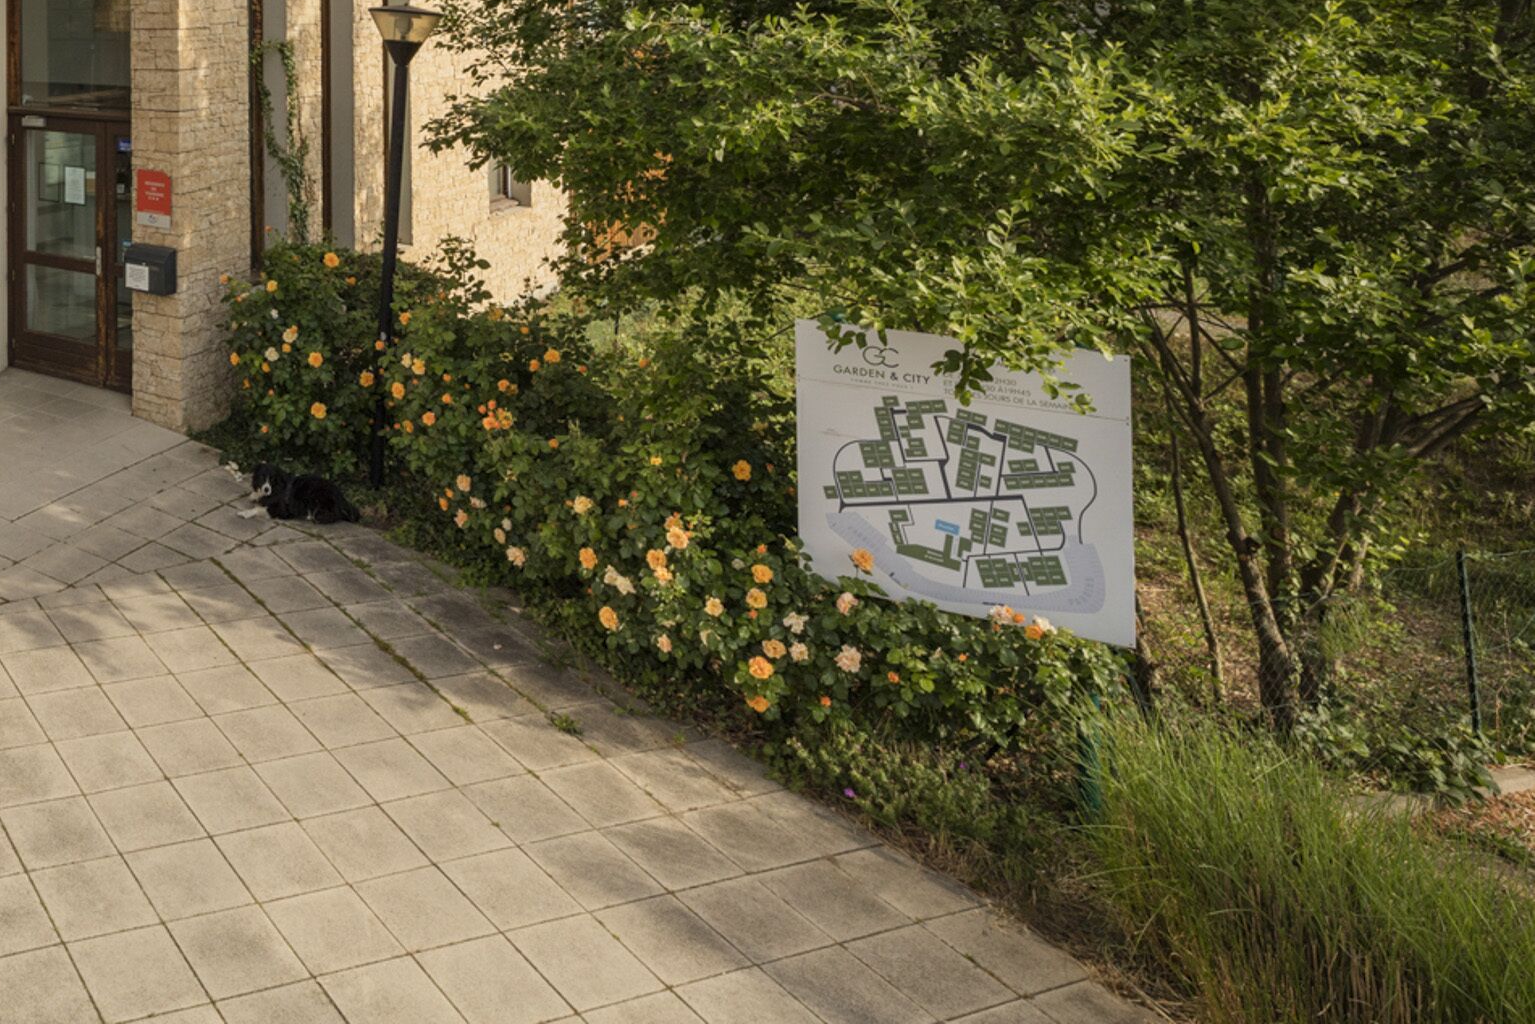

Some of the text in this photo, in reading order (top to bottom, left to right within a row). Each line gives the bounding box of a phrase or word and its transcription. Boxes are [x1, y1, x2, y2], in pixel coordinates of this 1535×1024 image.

[862, 345, 900, 368] GC
[833, 364, 885, 379] GARDEN
[889, 371, 899, 381] &
[902, 373, 931, 385] CITY
[1013, 396, 1024, 405] DE
[1026, 398, 1037, 406] LA
